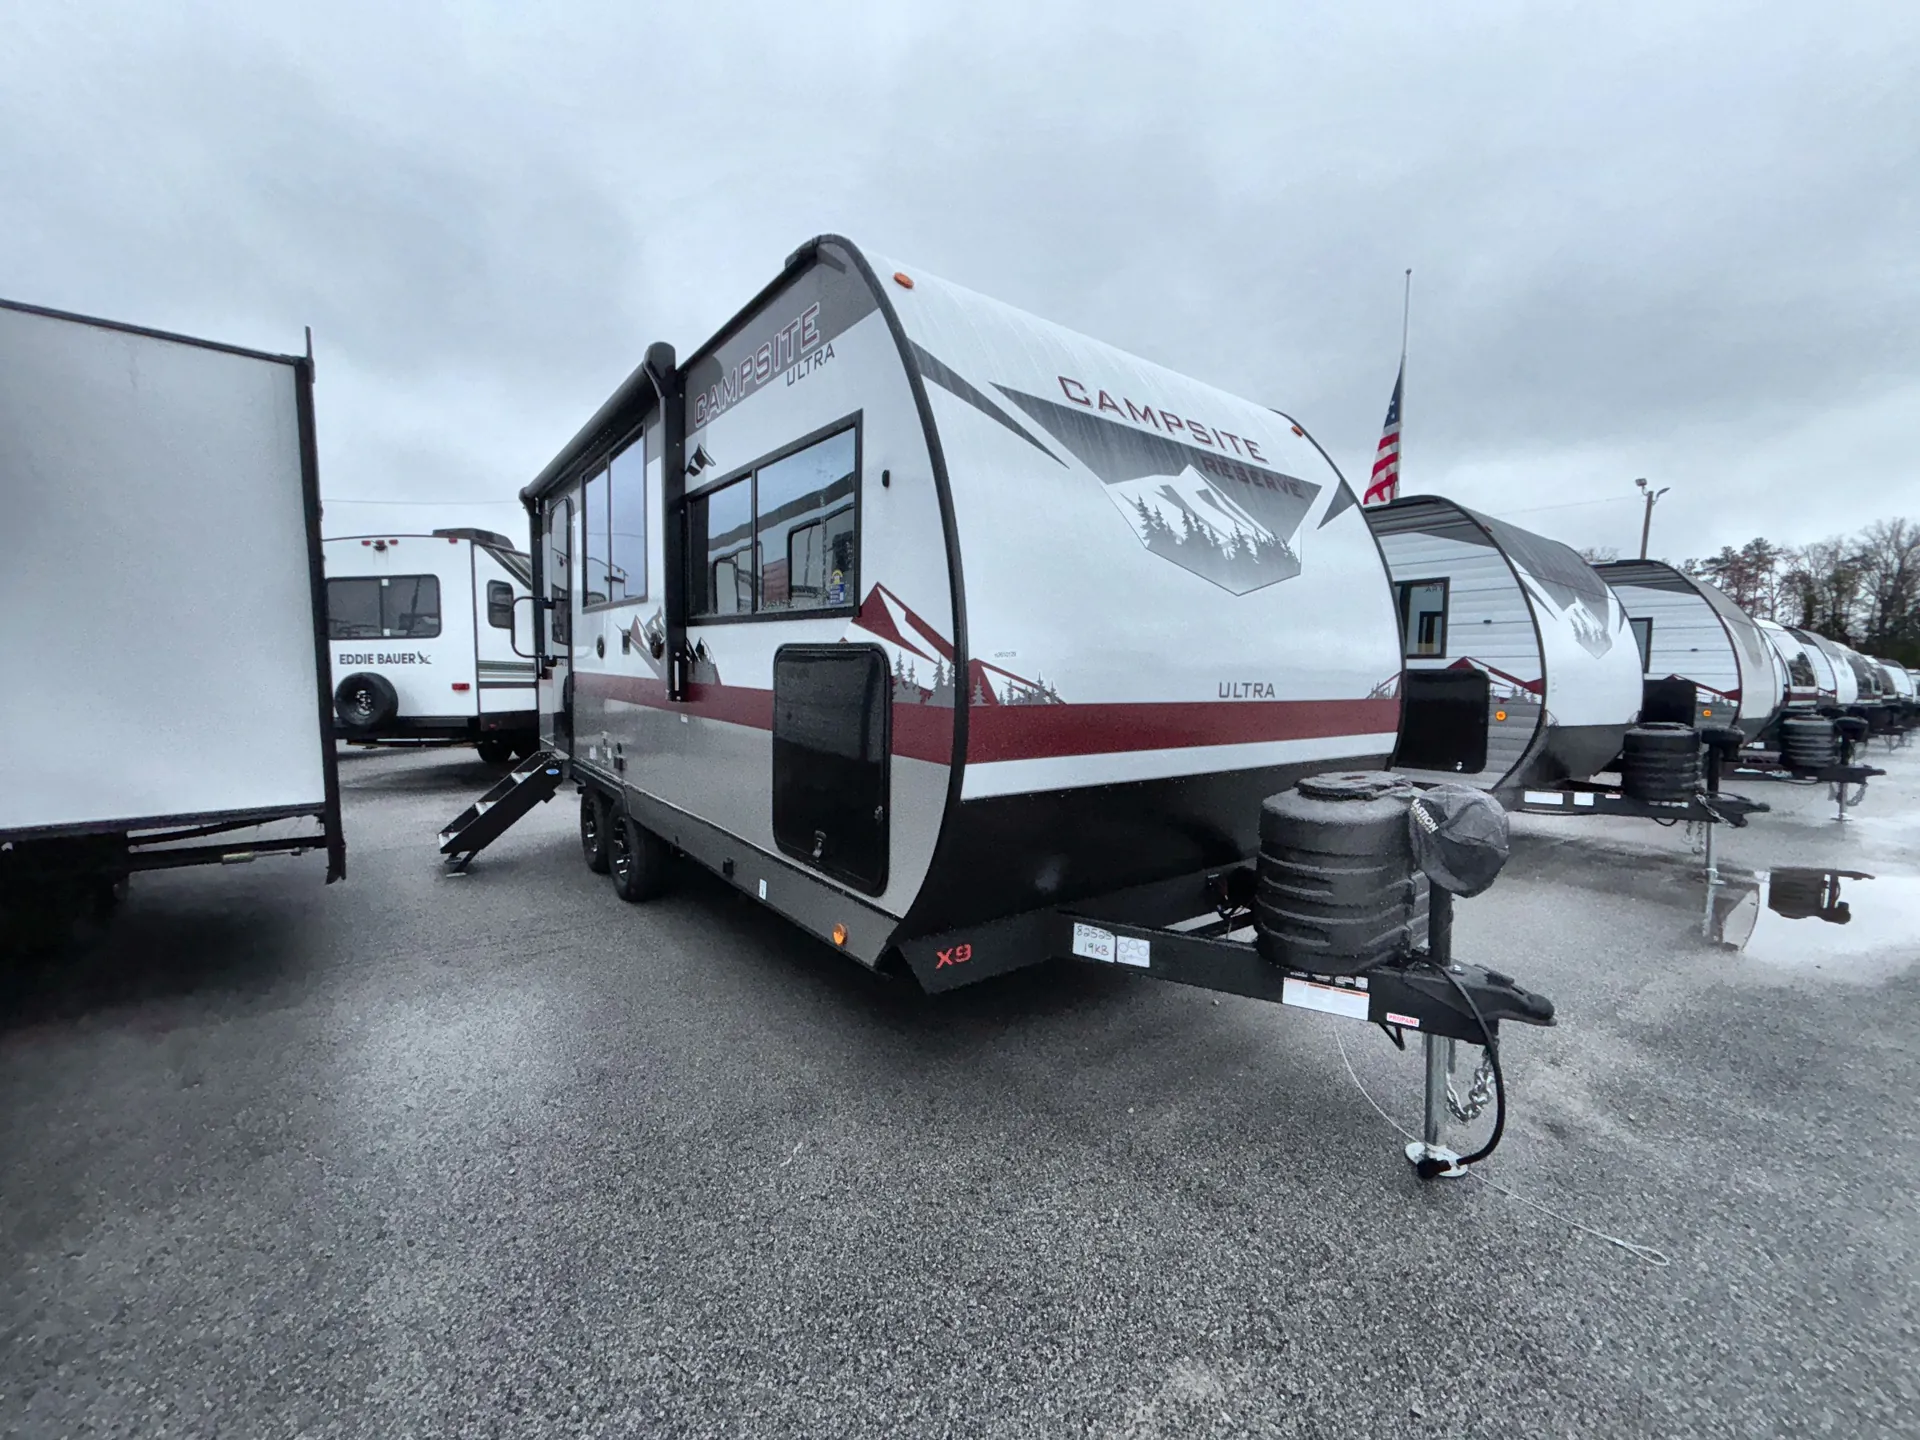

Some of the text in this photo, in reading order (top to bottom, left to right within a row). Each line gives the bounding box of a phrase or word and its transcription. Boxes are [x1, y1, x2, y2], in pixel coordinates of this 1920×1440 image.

[694, 301, 821, 429] CAMPSITE
[786, 342, 836, 388] ULTRA
[1057, 375, 1269, 465] CAMPSITE
[1200, 455, 1305, 500] RESERVE
[339, 653, 417, 665] EDDIE BAUER
[1218, 682, 1276, 698] ULTRA
[1388, 1014, 1418, 1026] PROPANE
